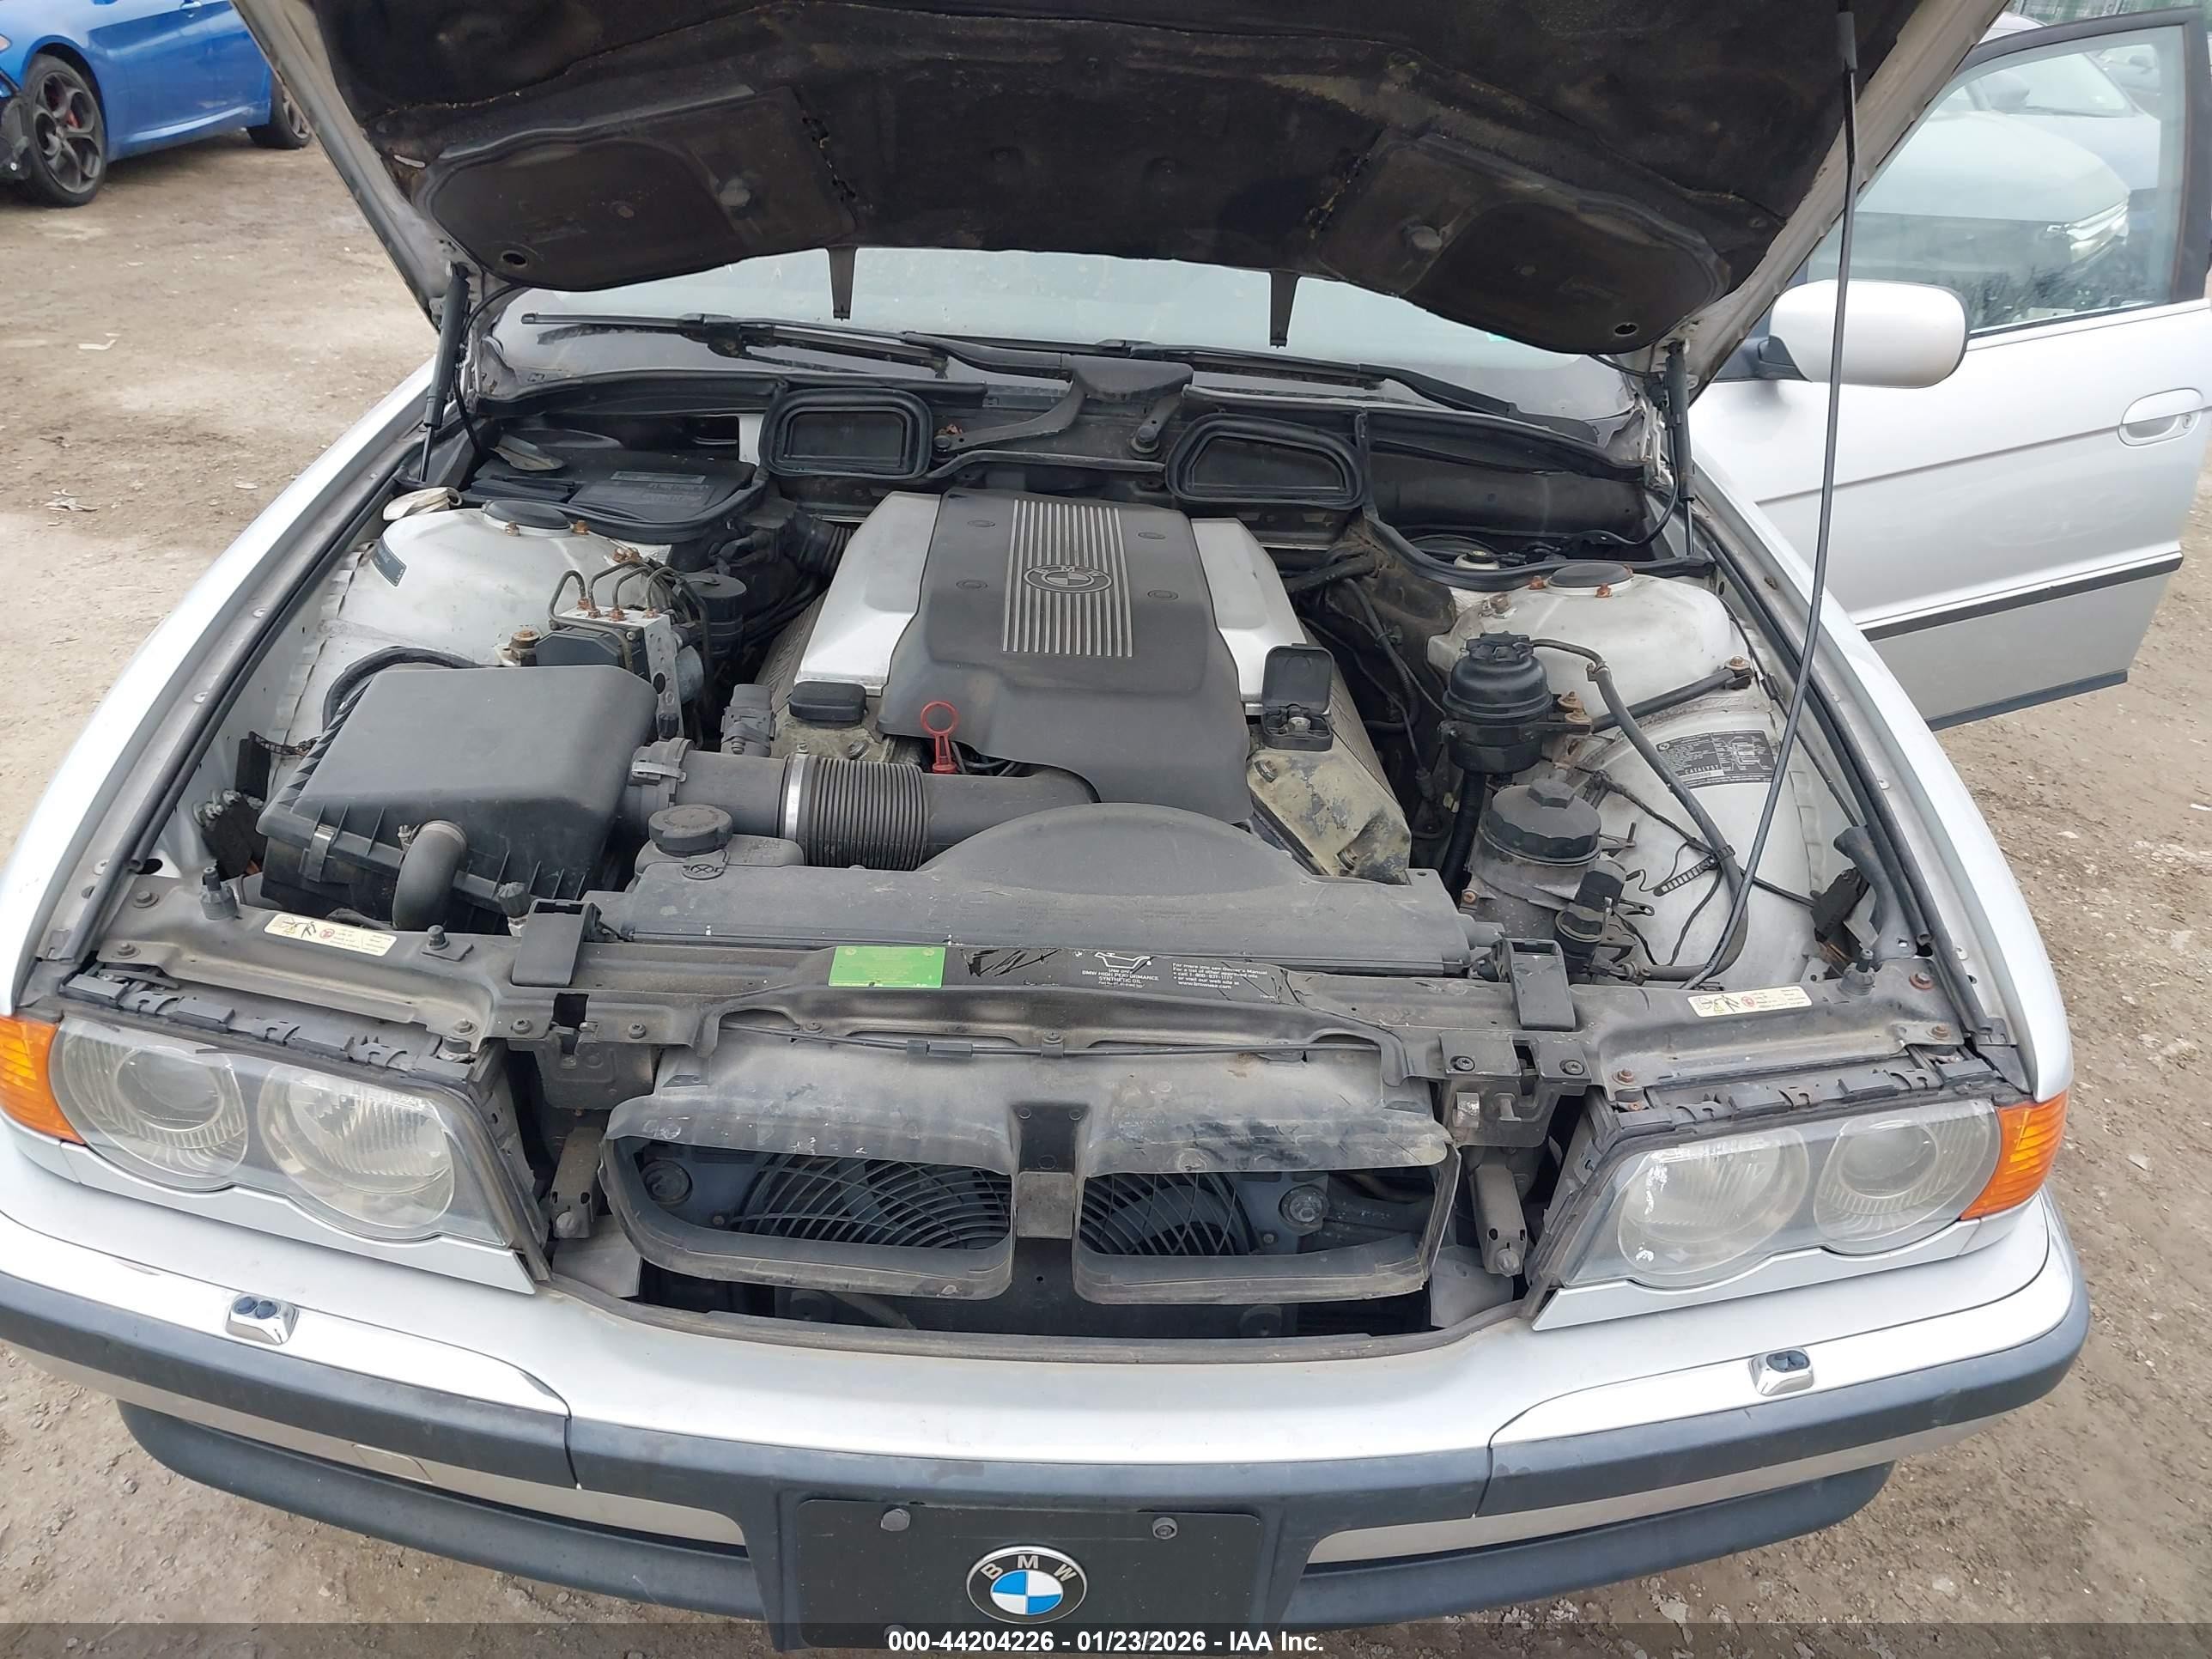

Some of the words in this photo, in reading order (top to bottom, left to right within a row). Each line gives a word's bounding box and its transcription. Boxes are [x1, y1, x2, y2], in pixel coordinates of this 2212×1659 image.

[1684, 764, 1719, 775] CATALYST
[1114, 972, 1159, 981] PERFORMANCE
[980, 1555, 1078, 1583] BMW
